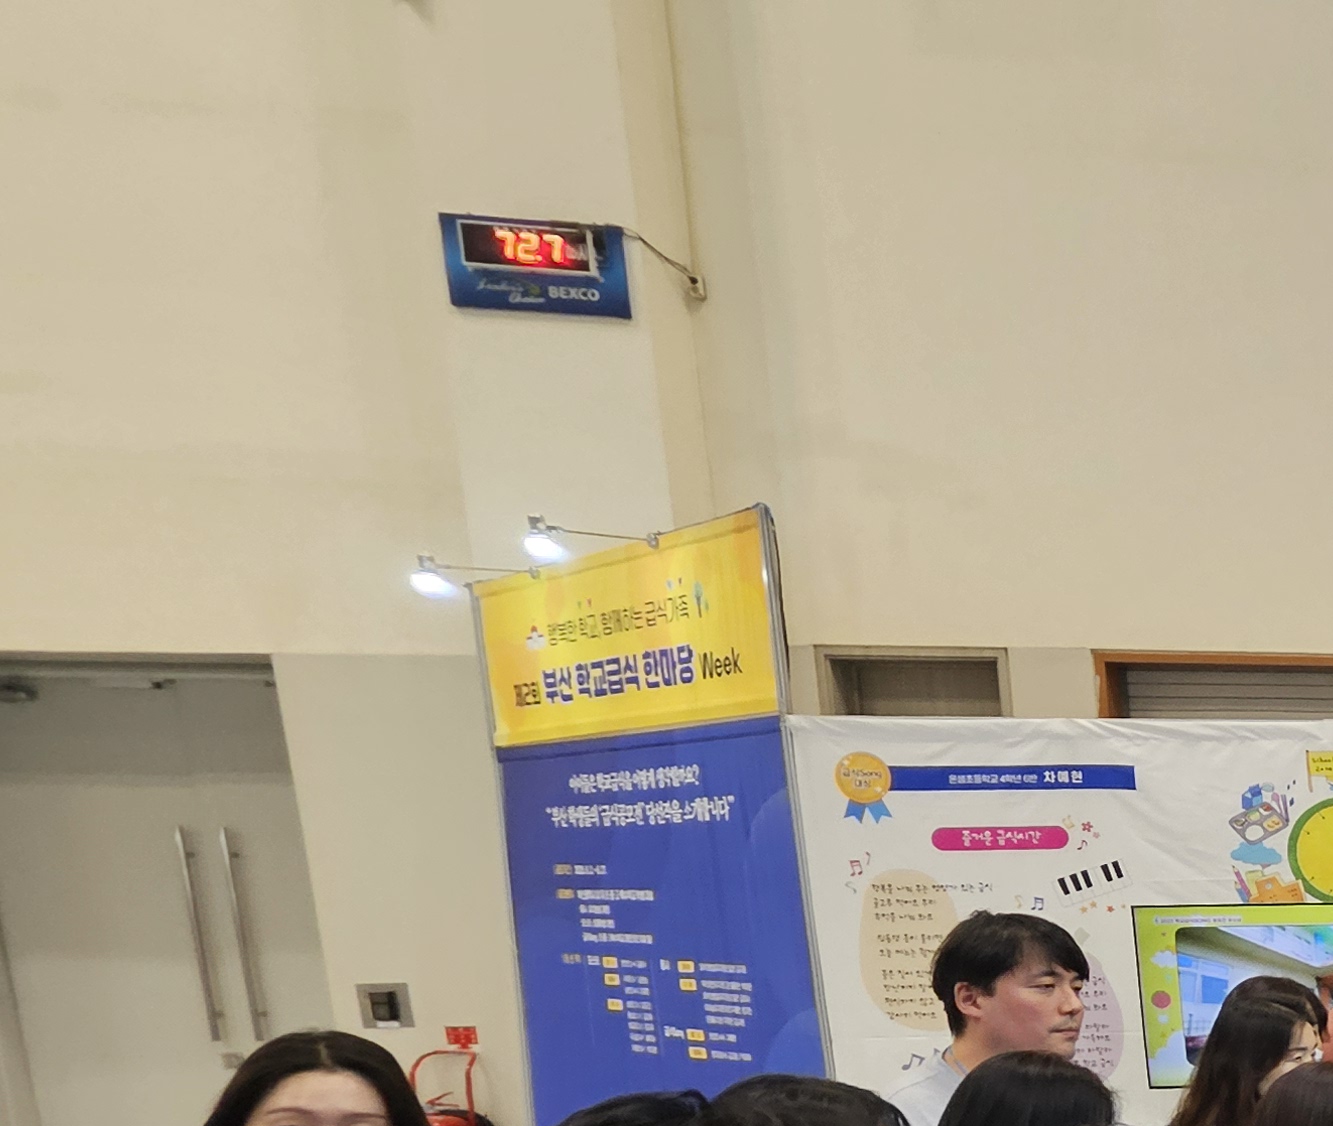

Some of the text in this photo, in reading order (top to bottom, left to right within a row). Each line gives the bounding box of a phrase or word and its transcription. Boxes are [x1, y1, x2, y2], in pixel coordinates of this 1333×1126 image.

[494, 228, 565, 264] 72.7
[547, 286, 600, 301] BEXCO
[542, 667, 573, 704] 부산
[576, 652, 641, 699] 학교급식
[641, 645, 695, 689] 한마당
[698, 647, 743, 680] Week
[961, 830, 1043, 846] 즐거운 급식시간
[977, 881, 993, 893] 급식
